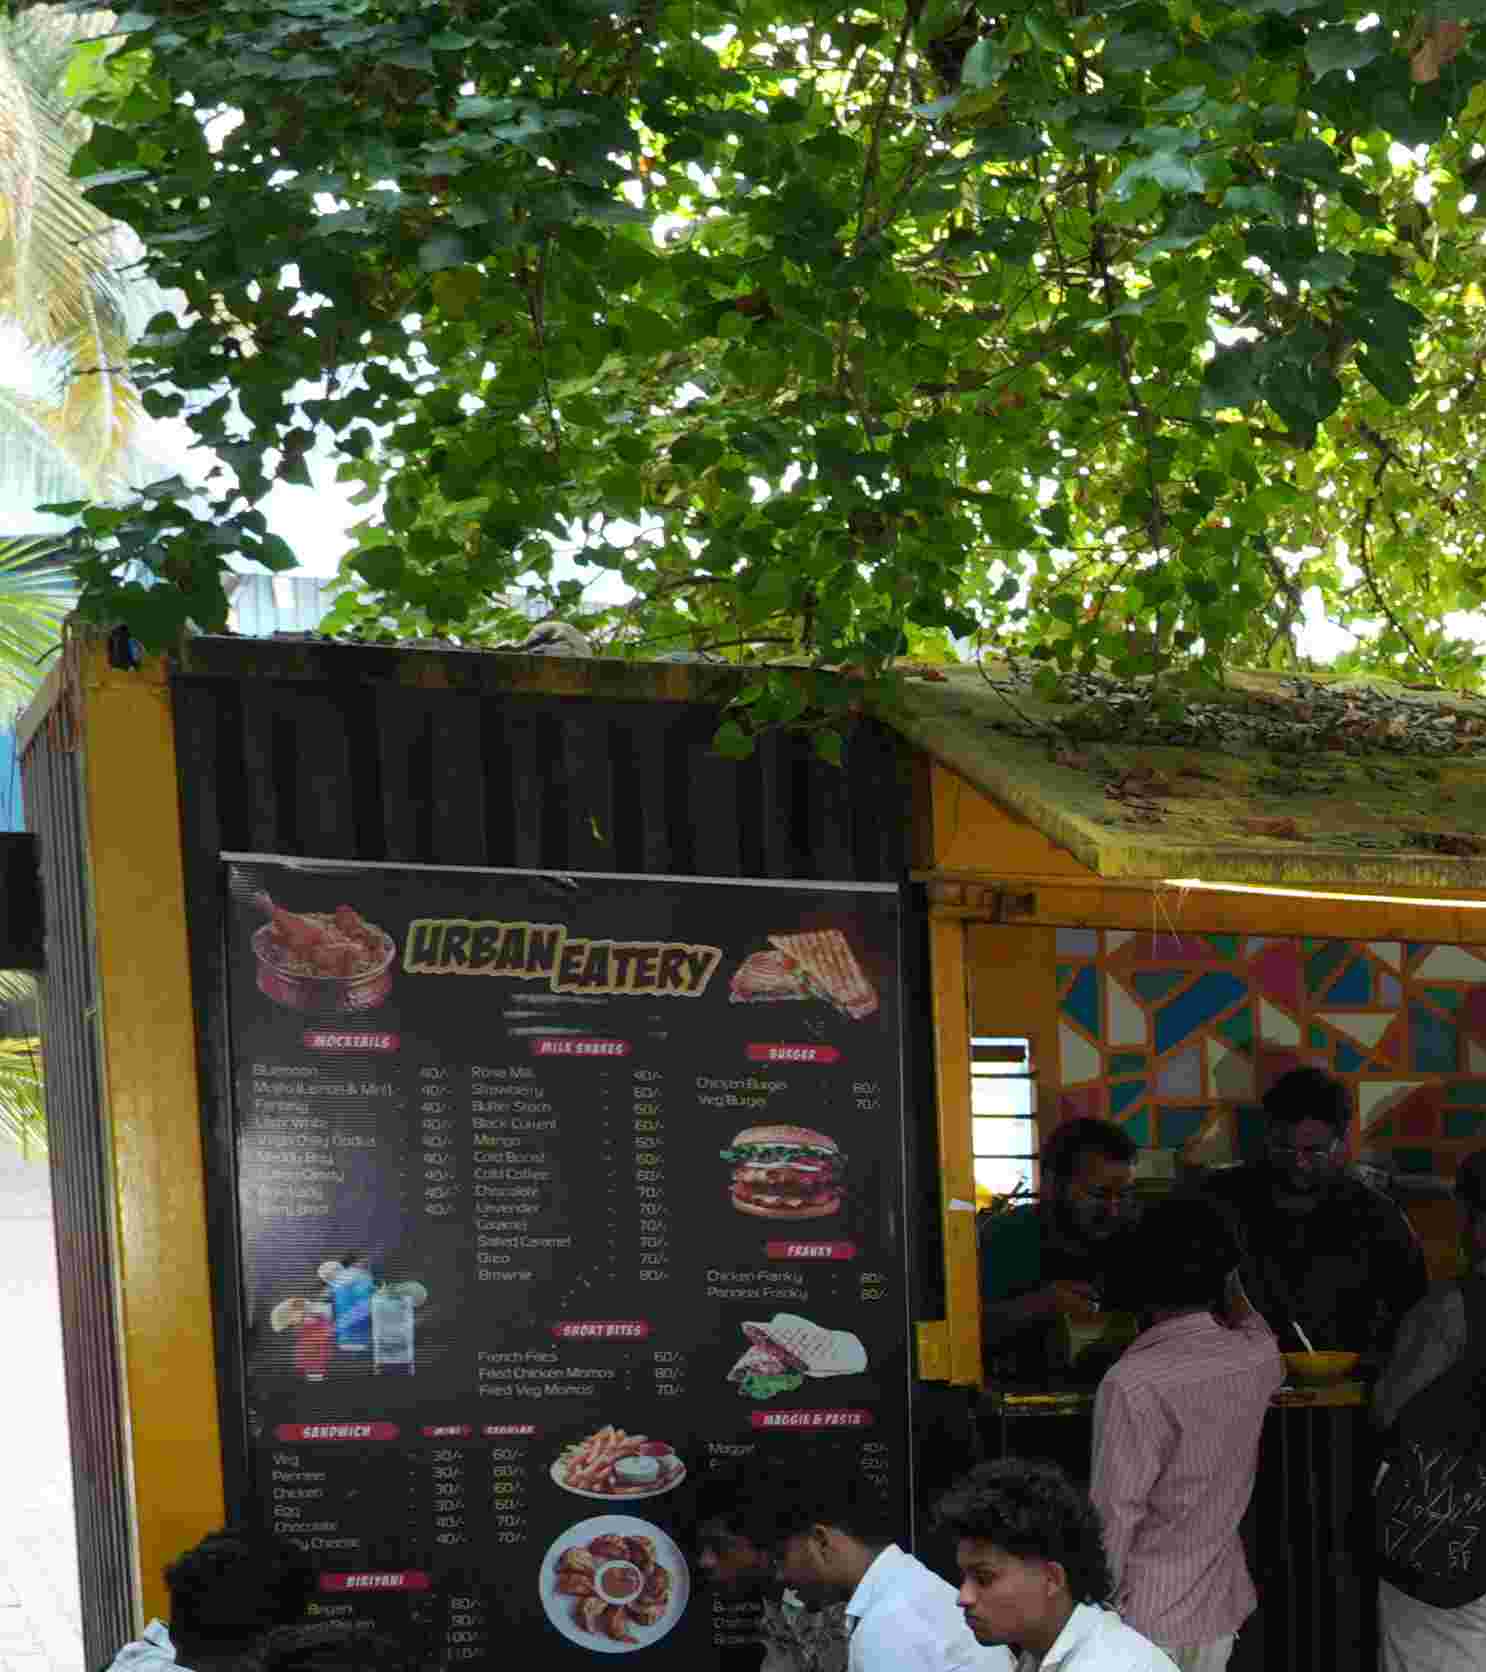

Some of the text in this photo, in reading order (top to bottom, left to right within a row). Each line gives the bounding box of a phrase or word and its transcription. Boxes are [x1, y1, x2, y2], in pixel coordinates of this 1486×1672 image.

[405, 920, 720, 995] URBAN EATERY
[313, 1034, 391, 1048] MOCKTAILS
[540, 1041, 625, 1055] MILK SHAKES
[768, 1048, 817, 1061] BURGER
[563, 1325, 642, 1337] SHORT BITES
[479, 1351, 522, 1363] French
[480, 1368, 513, 1381] Fried
[515, 1368, 564, 1381] Chicken
[567, 1368, 615, 1381] Momos
[480, 1385, 513, 1398] Fried
[516, 1385, 543, 1401] Veg
[825, 1413, 863, 1426] PASTA
[302, 1425, 372, 1438] SANDWICH
[272, 1452, 300, 1467] Veg
[273, 1487, 324, 1499] Chicken
[273, 1503, 301, 1519] Egg
